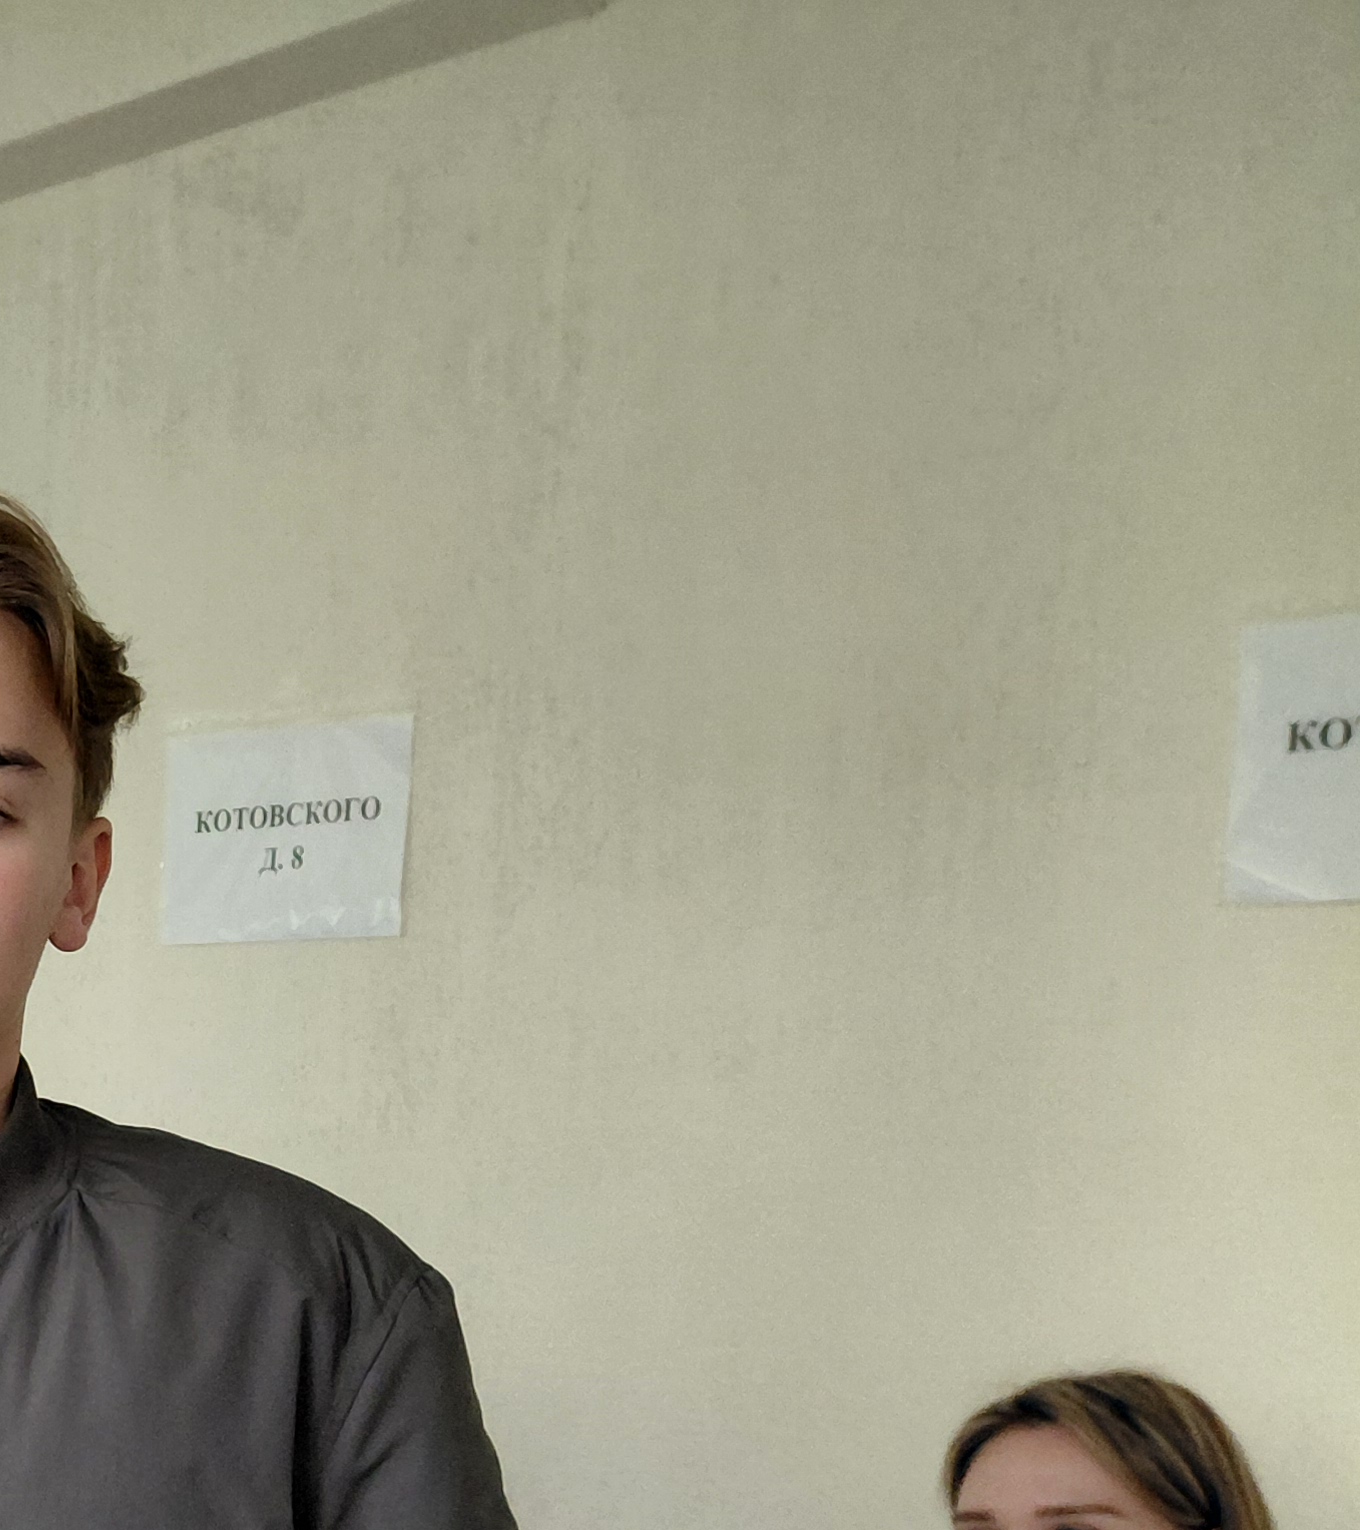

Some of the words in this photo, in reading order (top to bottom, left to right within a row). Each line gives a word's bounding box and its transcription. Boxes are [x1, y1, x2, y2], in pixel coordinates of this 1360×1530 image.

[1288, 716, 1360, 753] КО
[195, 795, 381, 833] КОТОВСКОГО
[258, 847, 283, 877] Д.
[291, 845, 305, 870] 8
